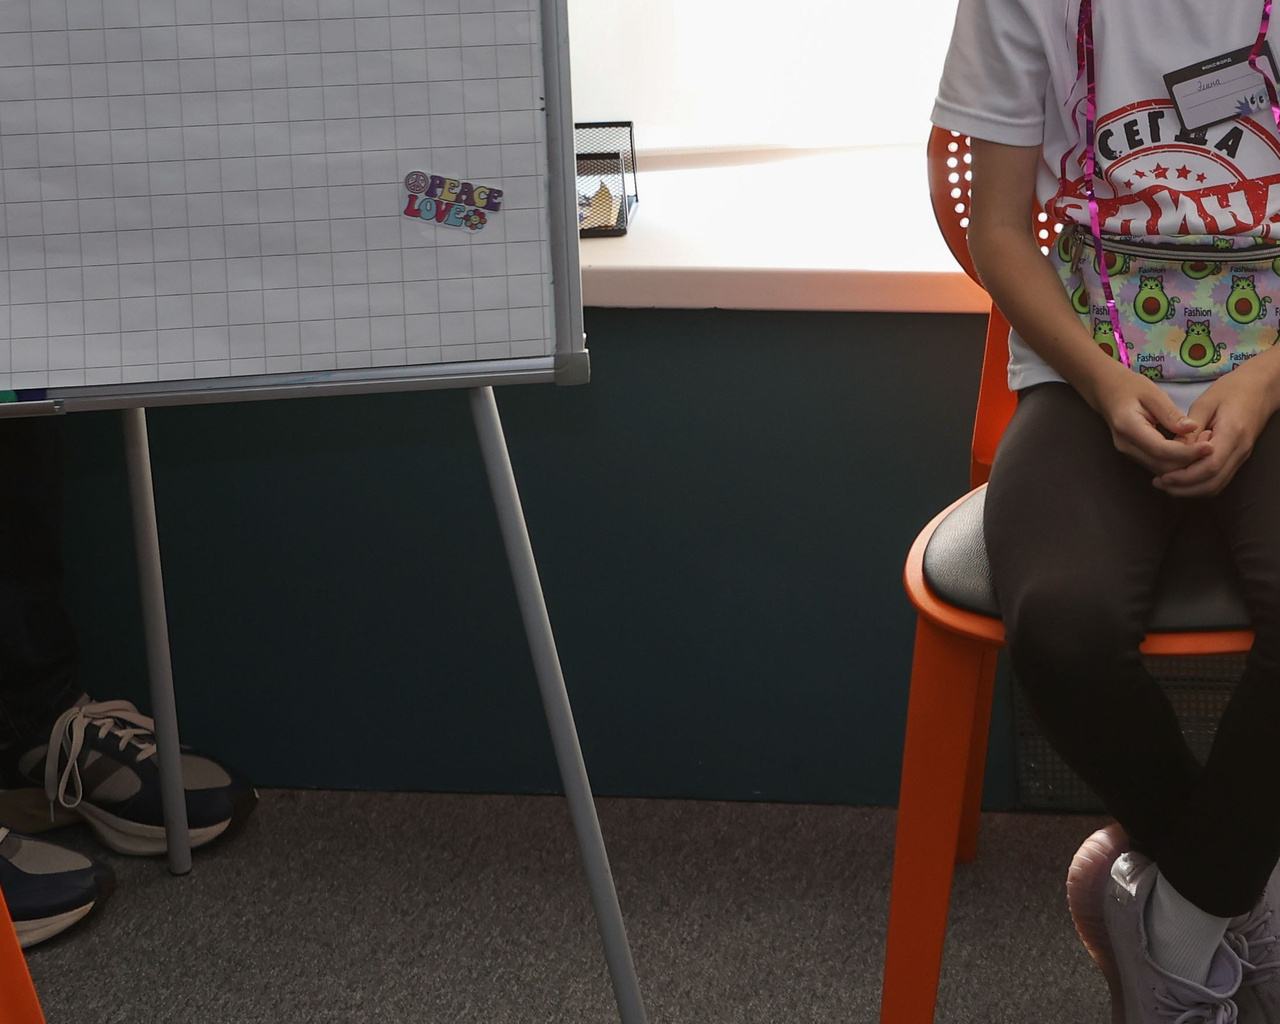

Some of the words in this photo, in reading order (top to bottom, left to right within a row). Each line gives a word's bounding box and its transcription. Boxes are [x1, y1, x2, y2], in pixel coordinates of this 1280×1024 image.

[425, 174, 504, 212] PEACE
[403, 194, 466, 227] LOVE
[1183, 307, 1212, 317] Fashion
[1137, 353, 1165, 362] Fashion
